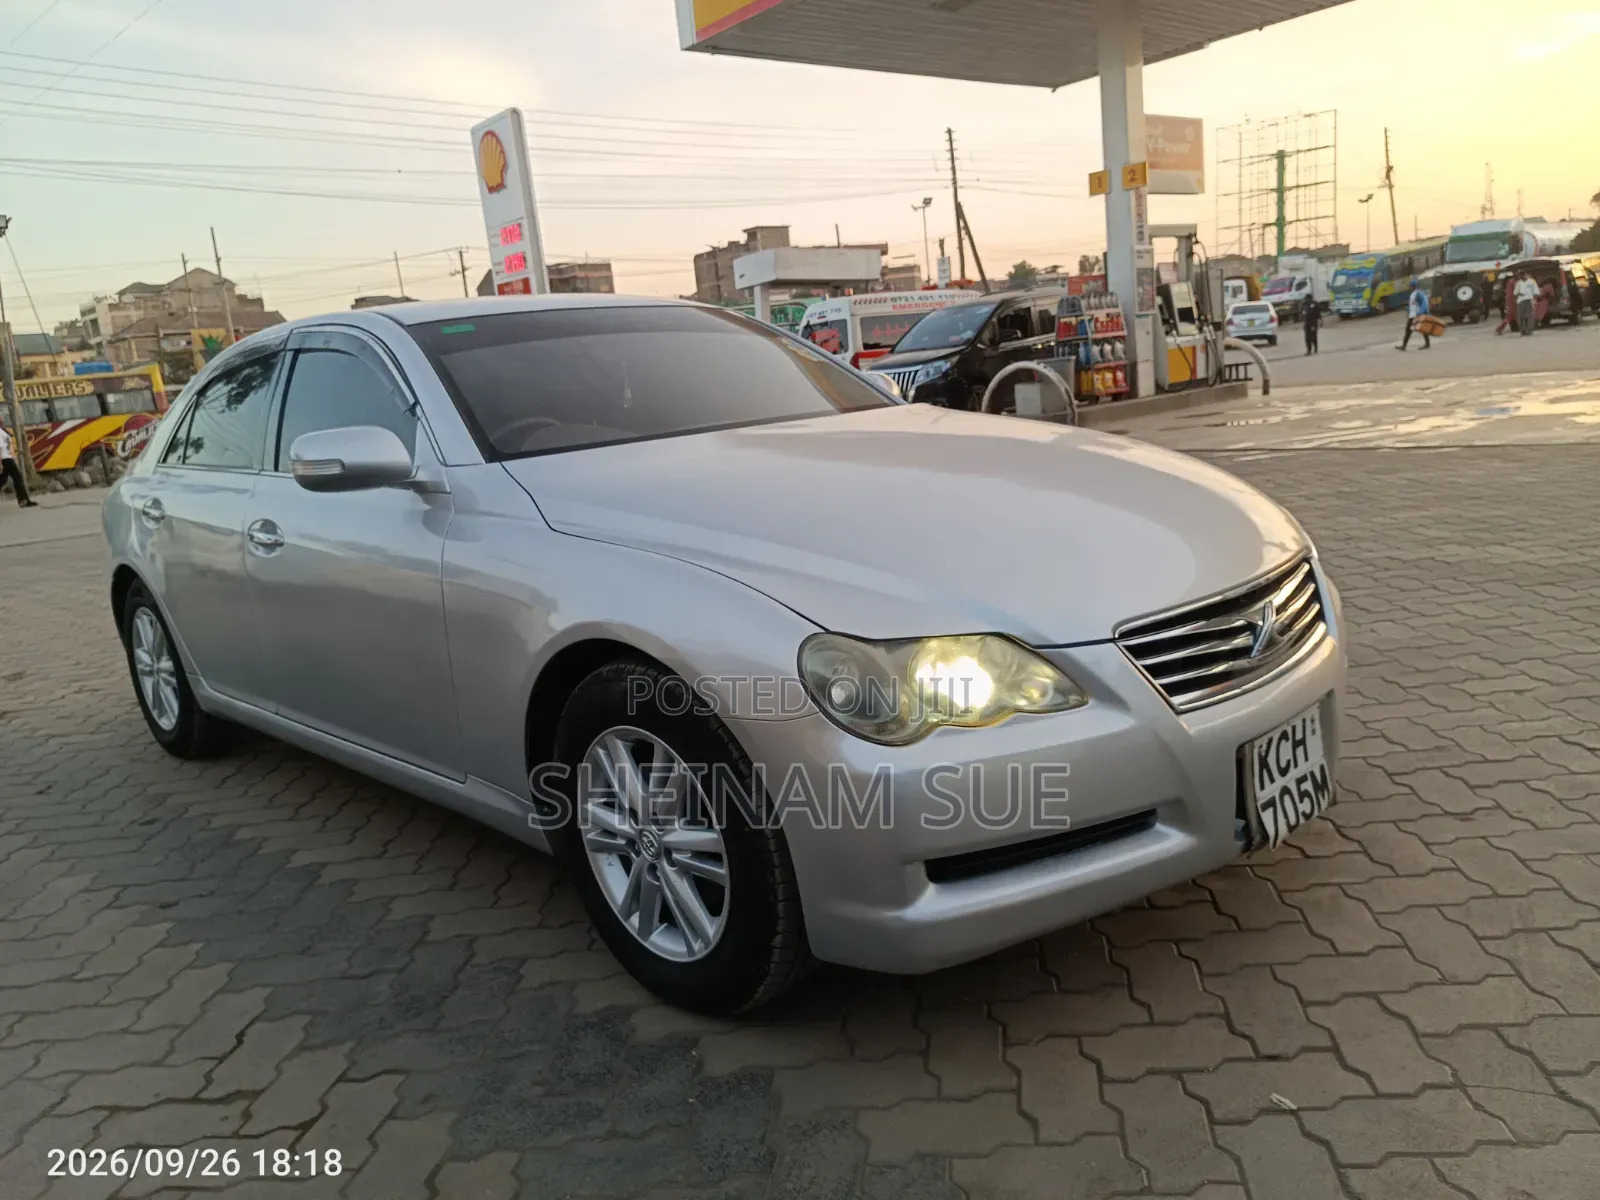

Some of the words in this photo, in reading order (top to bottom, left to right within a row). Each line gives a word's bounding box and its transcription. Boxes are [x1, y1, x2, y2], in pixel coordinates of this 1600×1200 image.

[1096, 175, 1102, 189] 1
[1127, 168, 1138, 183] 2
[1257, 718, 1309, 792] KCH
[1260, 764, 1331, 849] 705M
